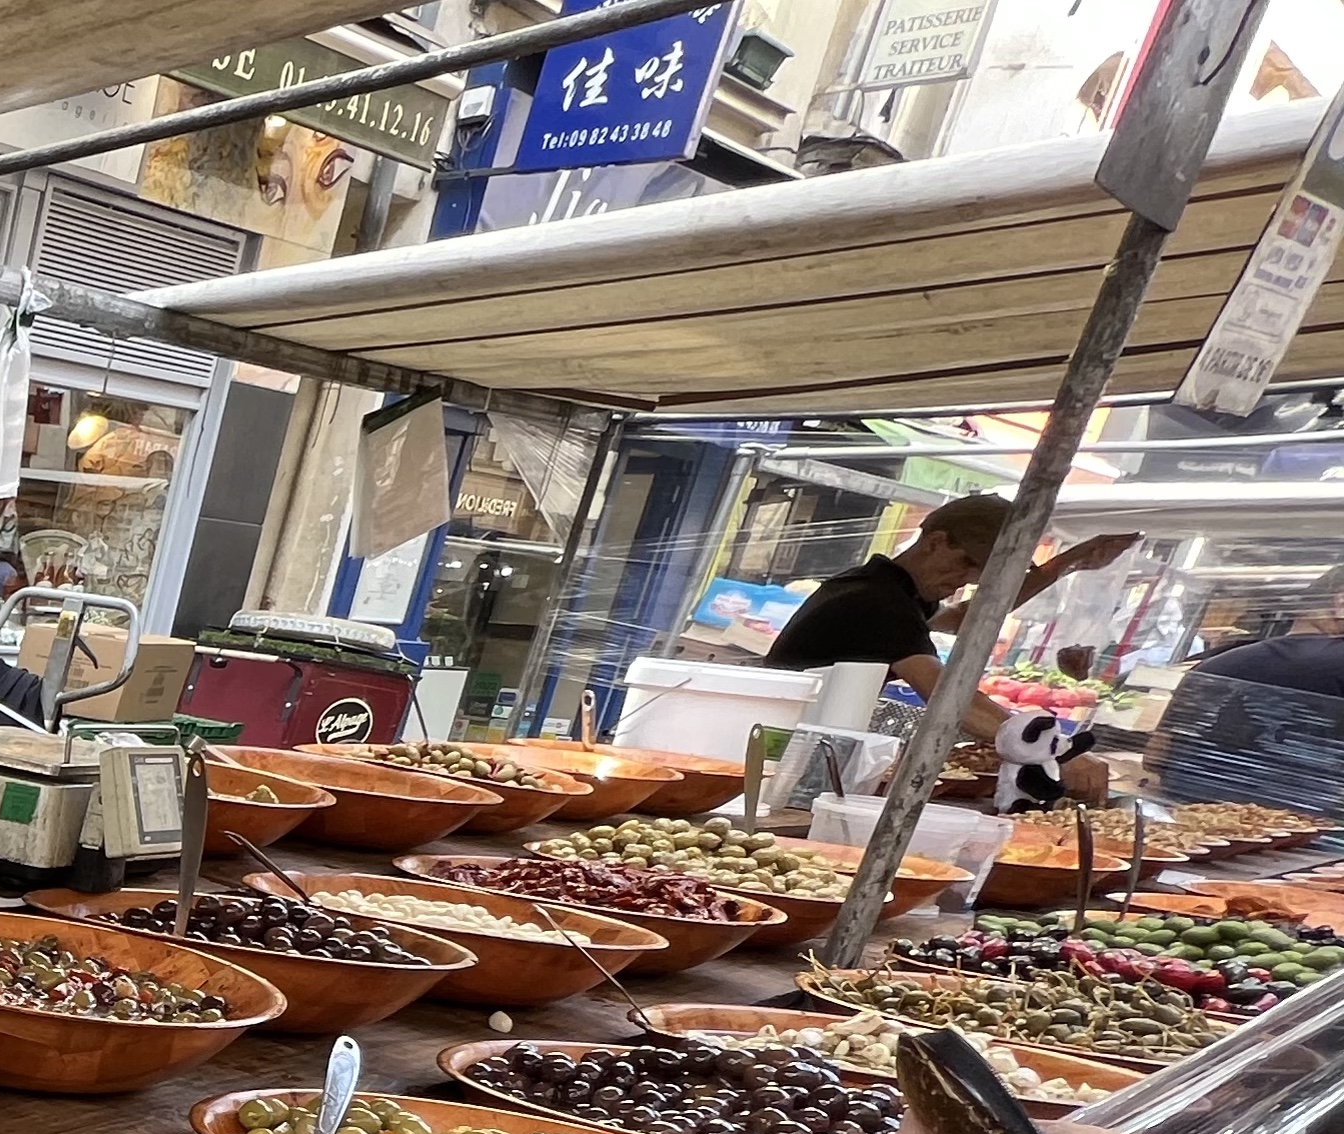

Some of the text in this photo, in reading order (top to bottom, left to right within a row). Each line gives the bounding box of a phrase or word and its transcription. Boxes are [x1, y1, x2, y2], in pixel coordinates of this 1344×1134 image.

[884, 6, 984, 36] PATISSERIE
[888, 30, 965, 56] SERVICE
[562, 41, 684, 112] 佳味
[873, 54, 965, 80] TRAITEUR
[588, 128, 606, 146] 82
[609, 124, 628, 143] 43
[630, 122, 650, 141] 38
[651, 119, 673, 138] 48
